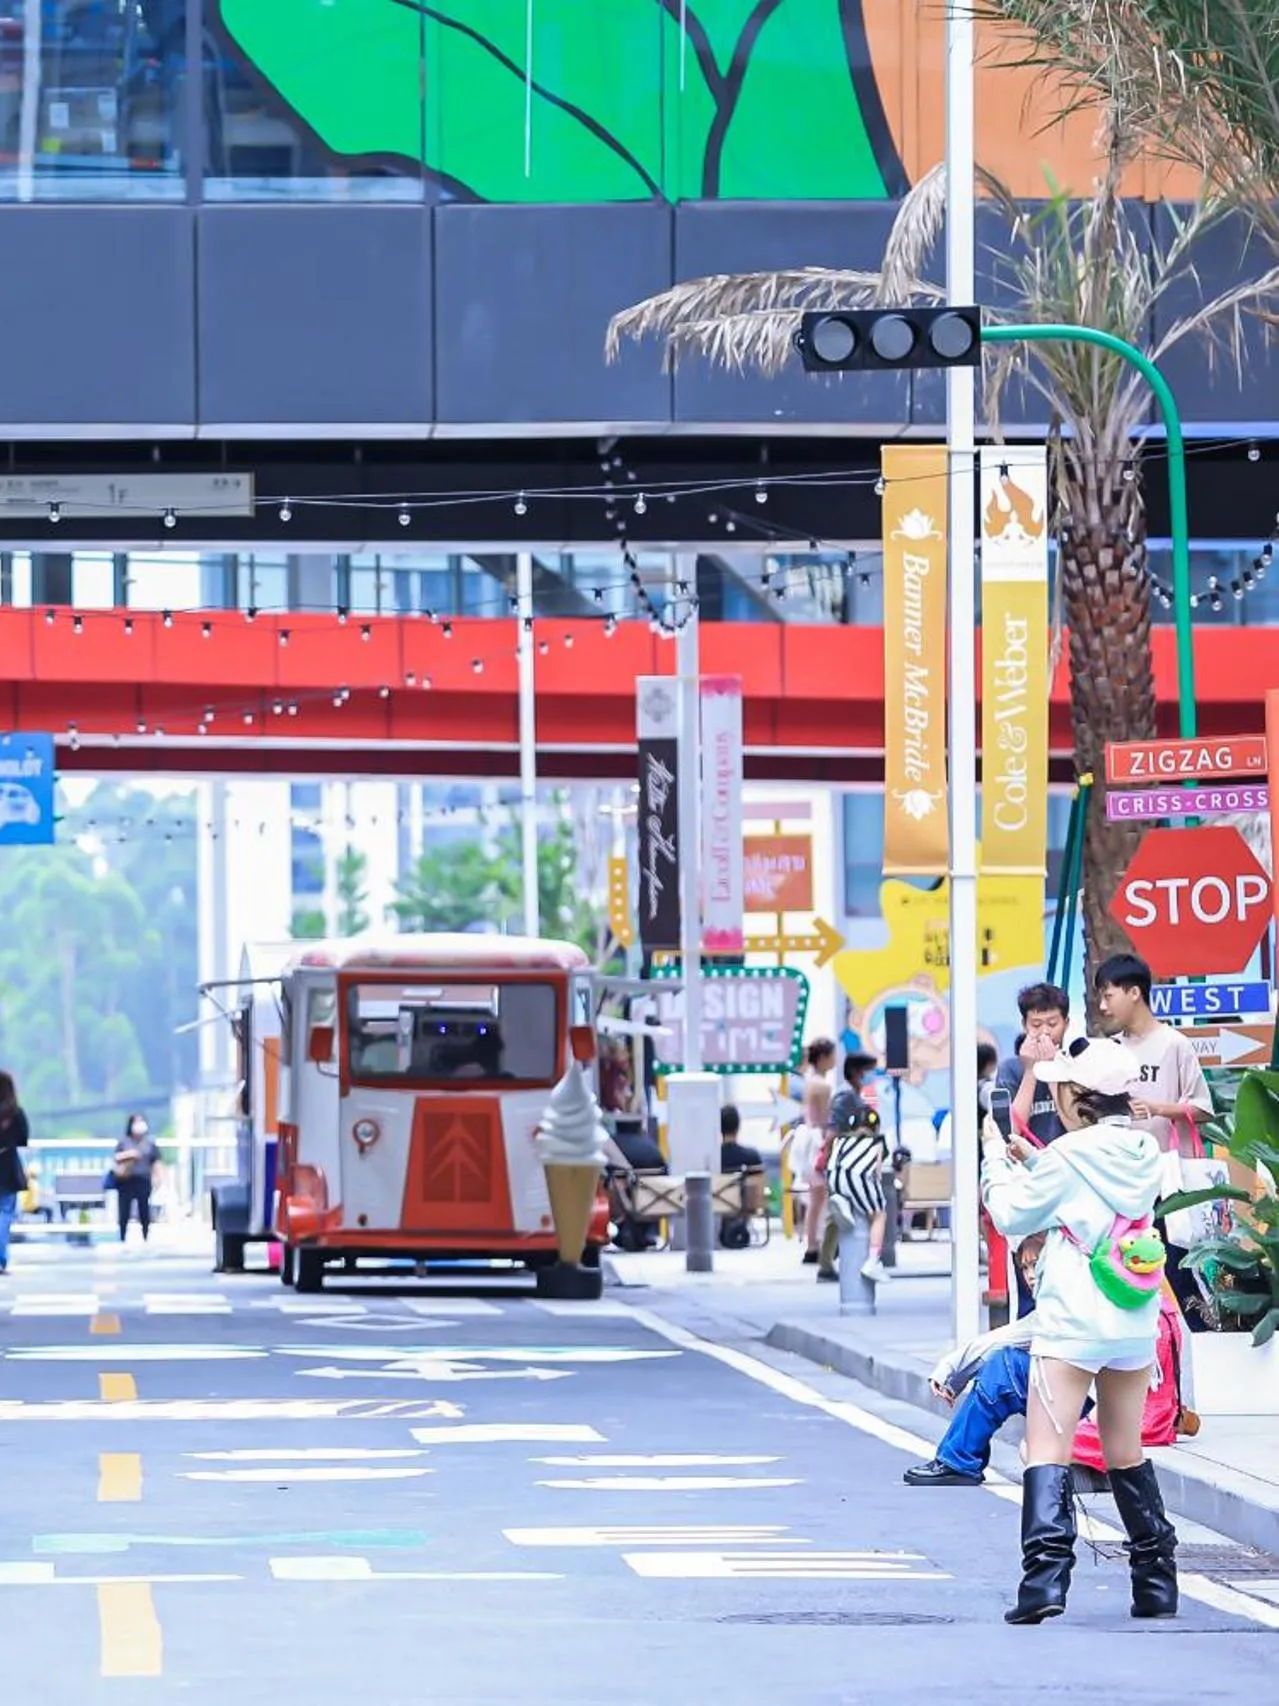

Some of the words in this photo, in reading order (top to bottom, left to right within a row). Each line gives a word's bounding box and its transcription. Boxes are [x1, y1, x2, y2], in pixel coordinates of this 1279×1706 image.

[903, 552, 930, 656] Banner
[992, 611, 1029, 723] Weber
[903, 660, 930, 782] McBride
[1130, 747, 1233, 775] ZIGZAG
[992, 757, 1029, 831] Cole
[1118, 791, 1268, 815] CRISS-CROSS
[1125, 875, 1269, 928] STOP
[1149, 986, 1245, 1014] WEST
